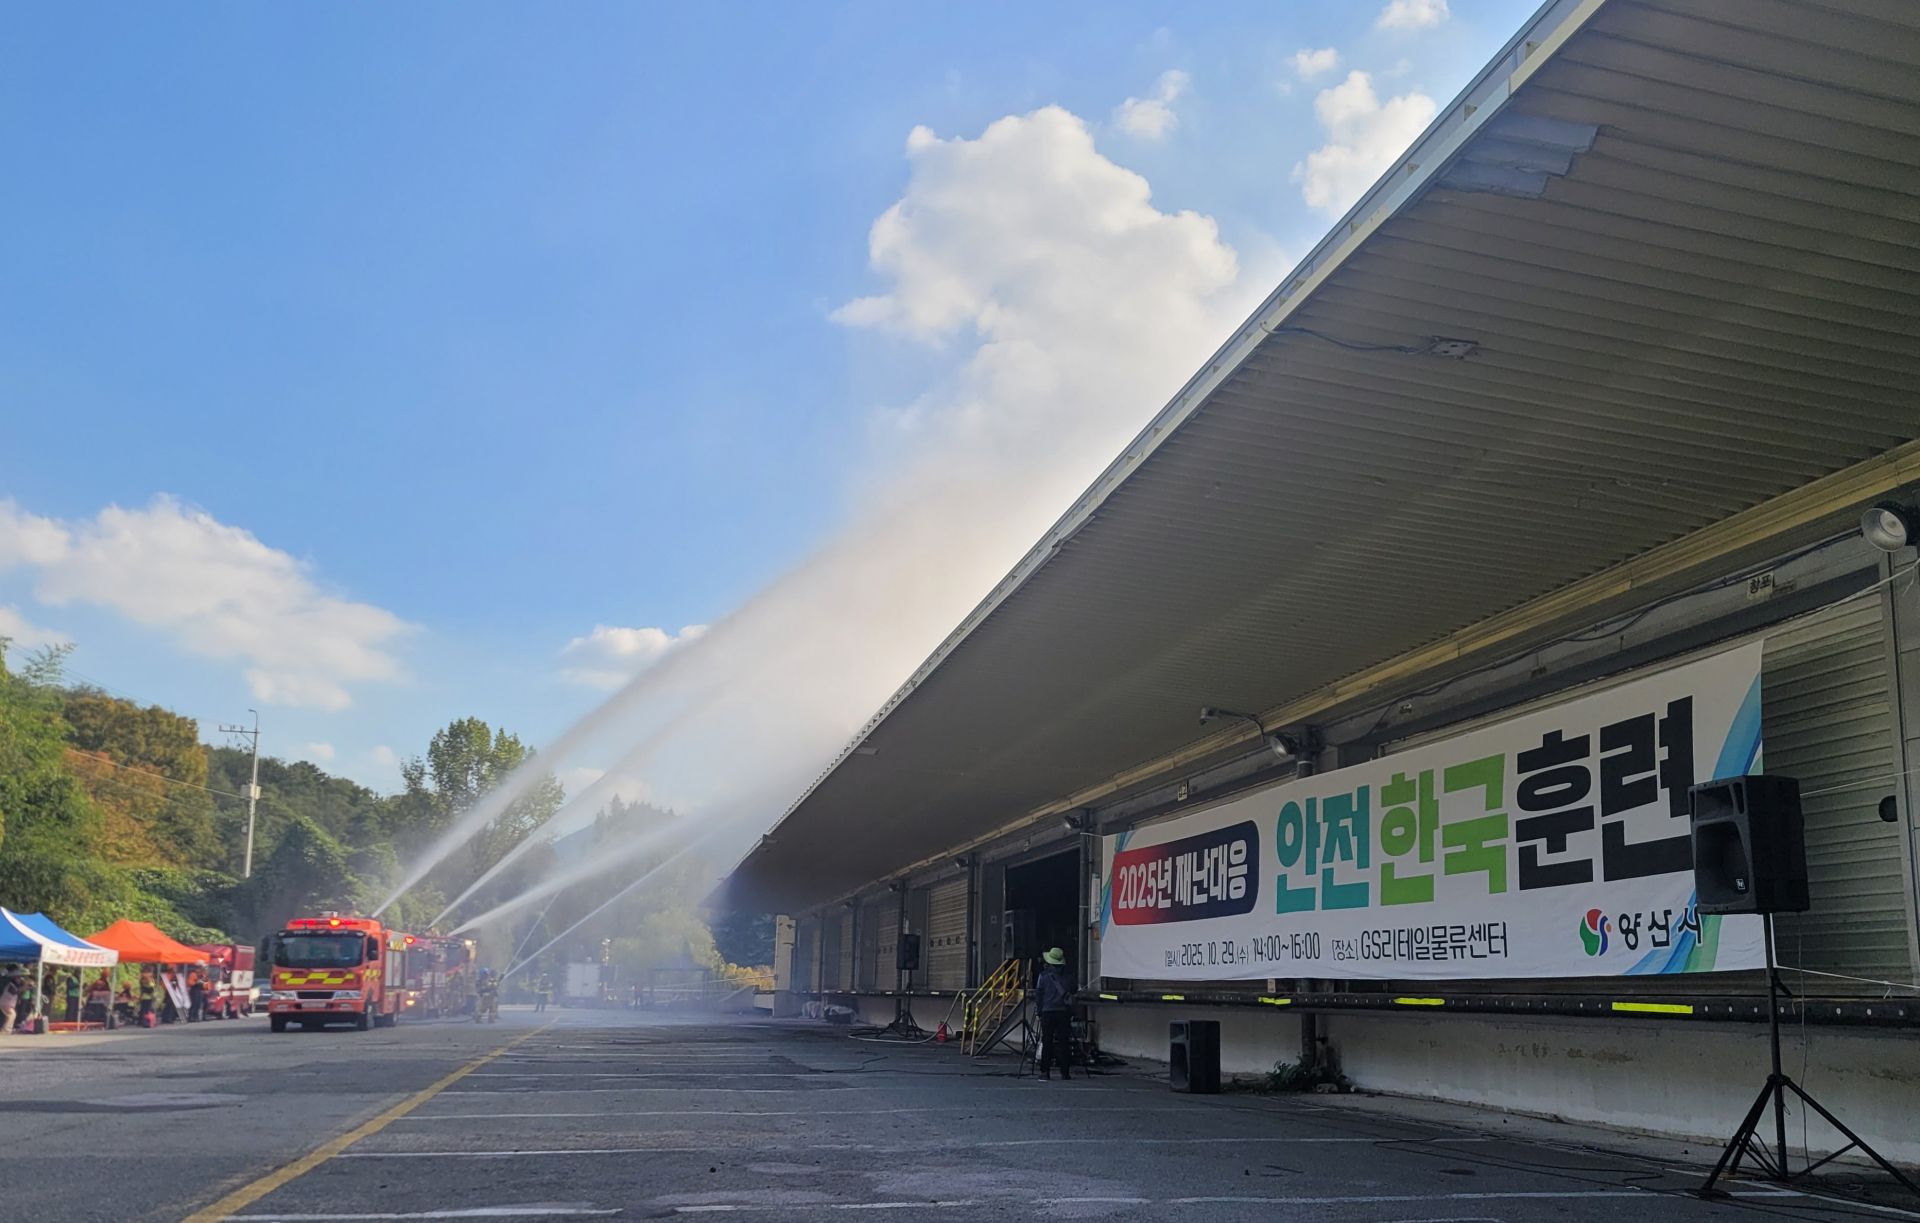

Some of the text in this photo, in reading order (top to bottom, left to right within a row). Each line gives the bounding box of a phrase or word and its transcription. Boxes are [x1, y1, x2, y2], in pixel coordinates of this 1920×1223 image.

[1118, 857, 1173, 909] 2025년
[1175, 839, 1248, 906] 재난대응
[1276, 695, 1698, 914] 안전한국훈련
[1252, 932, 1321, 961] 14:00~16:00
[1331, 939, 1359, 961] [장소]
[1361, 921, 1508, 961] GS리테일물류센터
[1618, 903, 1703, 951] 양산시
